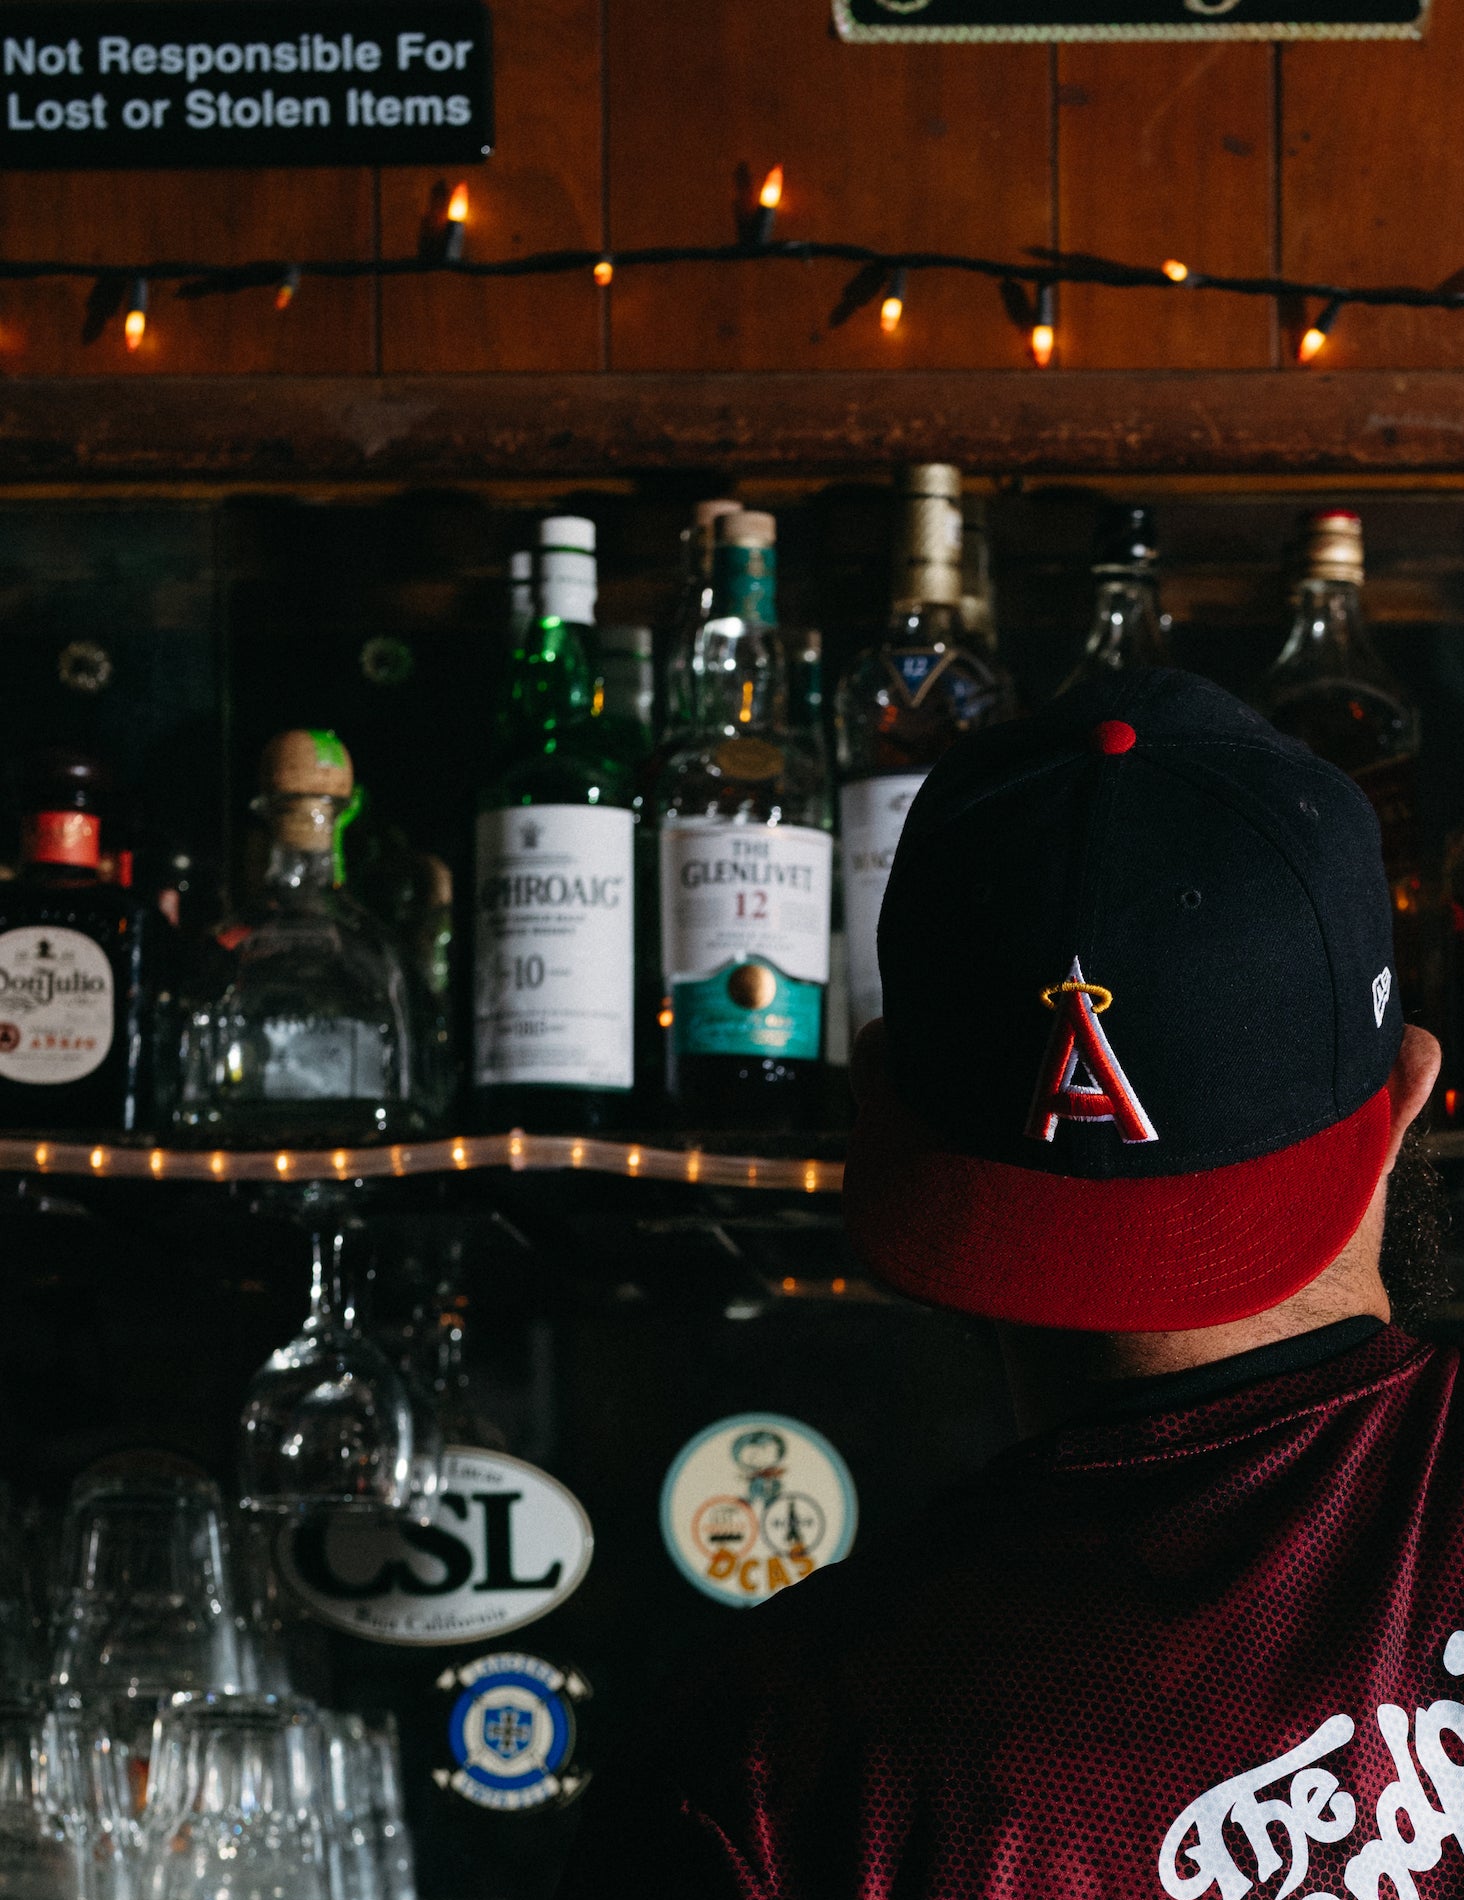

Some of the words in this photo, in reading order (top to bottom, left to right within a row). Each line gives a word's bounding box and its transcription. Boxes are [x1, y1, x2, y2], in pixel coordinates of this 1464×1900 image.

[4, 38, 83, 76] Not
[99, 34, 382, 83] Responsible
[398, 33, 474, 72] For
[8, 92, 107, 130] Lost
[122, 98, 171, 129] or
[185, 89, 331, 128] Stolen
[346, 88, 472, 127] Items
[680, 859, 813, 893] GLENLIVET
[736, 890, 768, 919] 12
[512, 953, 546, 990] 10
[1024, 955, 1159, 1143] A
